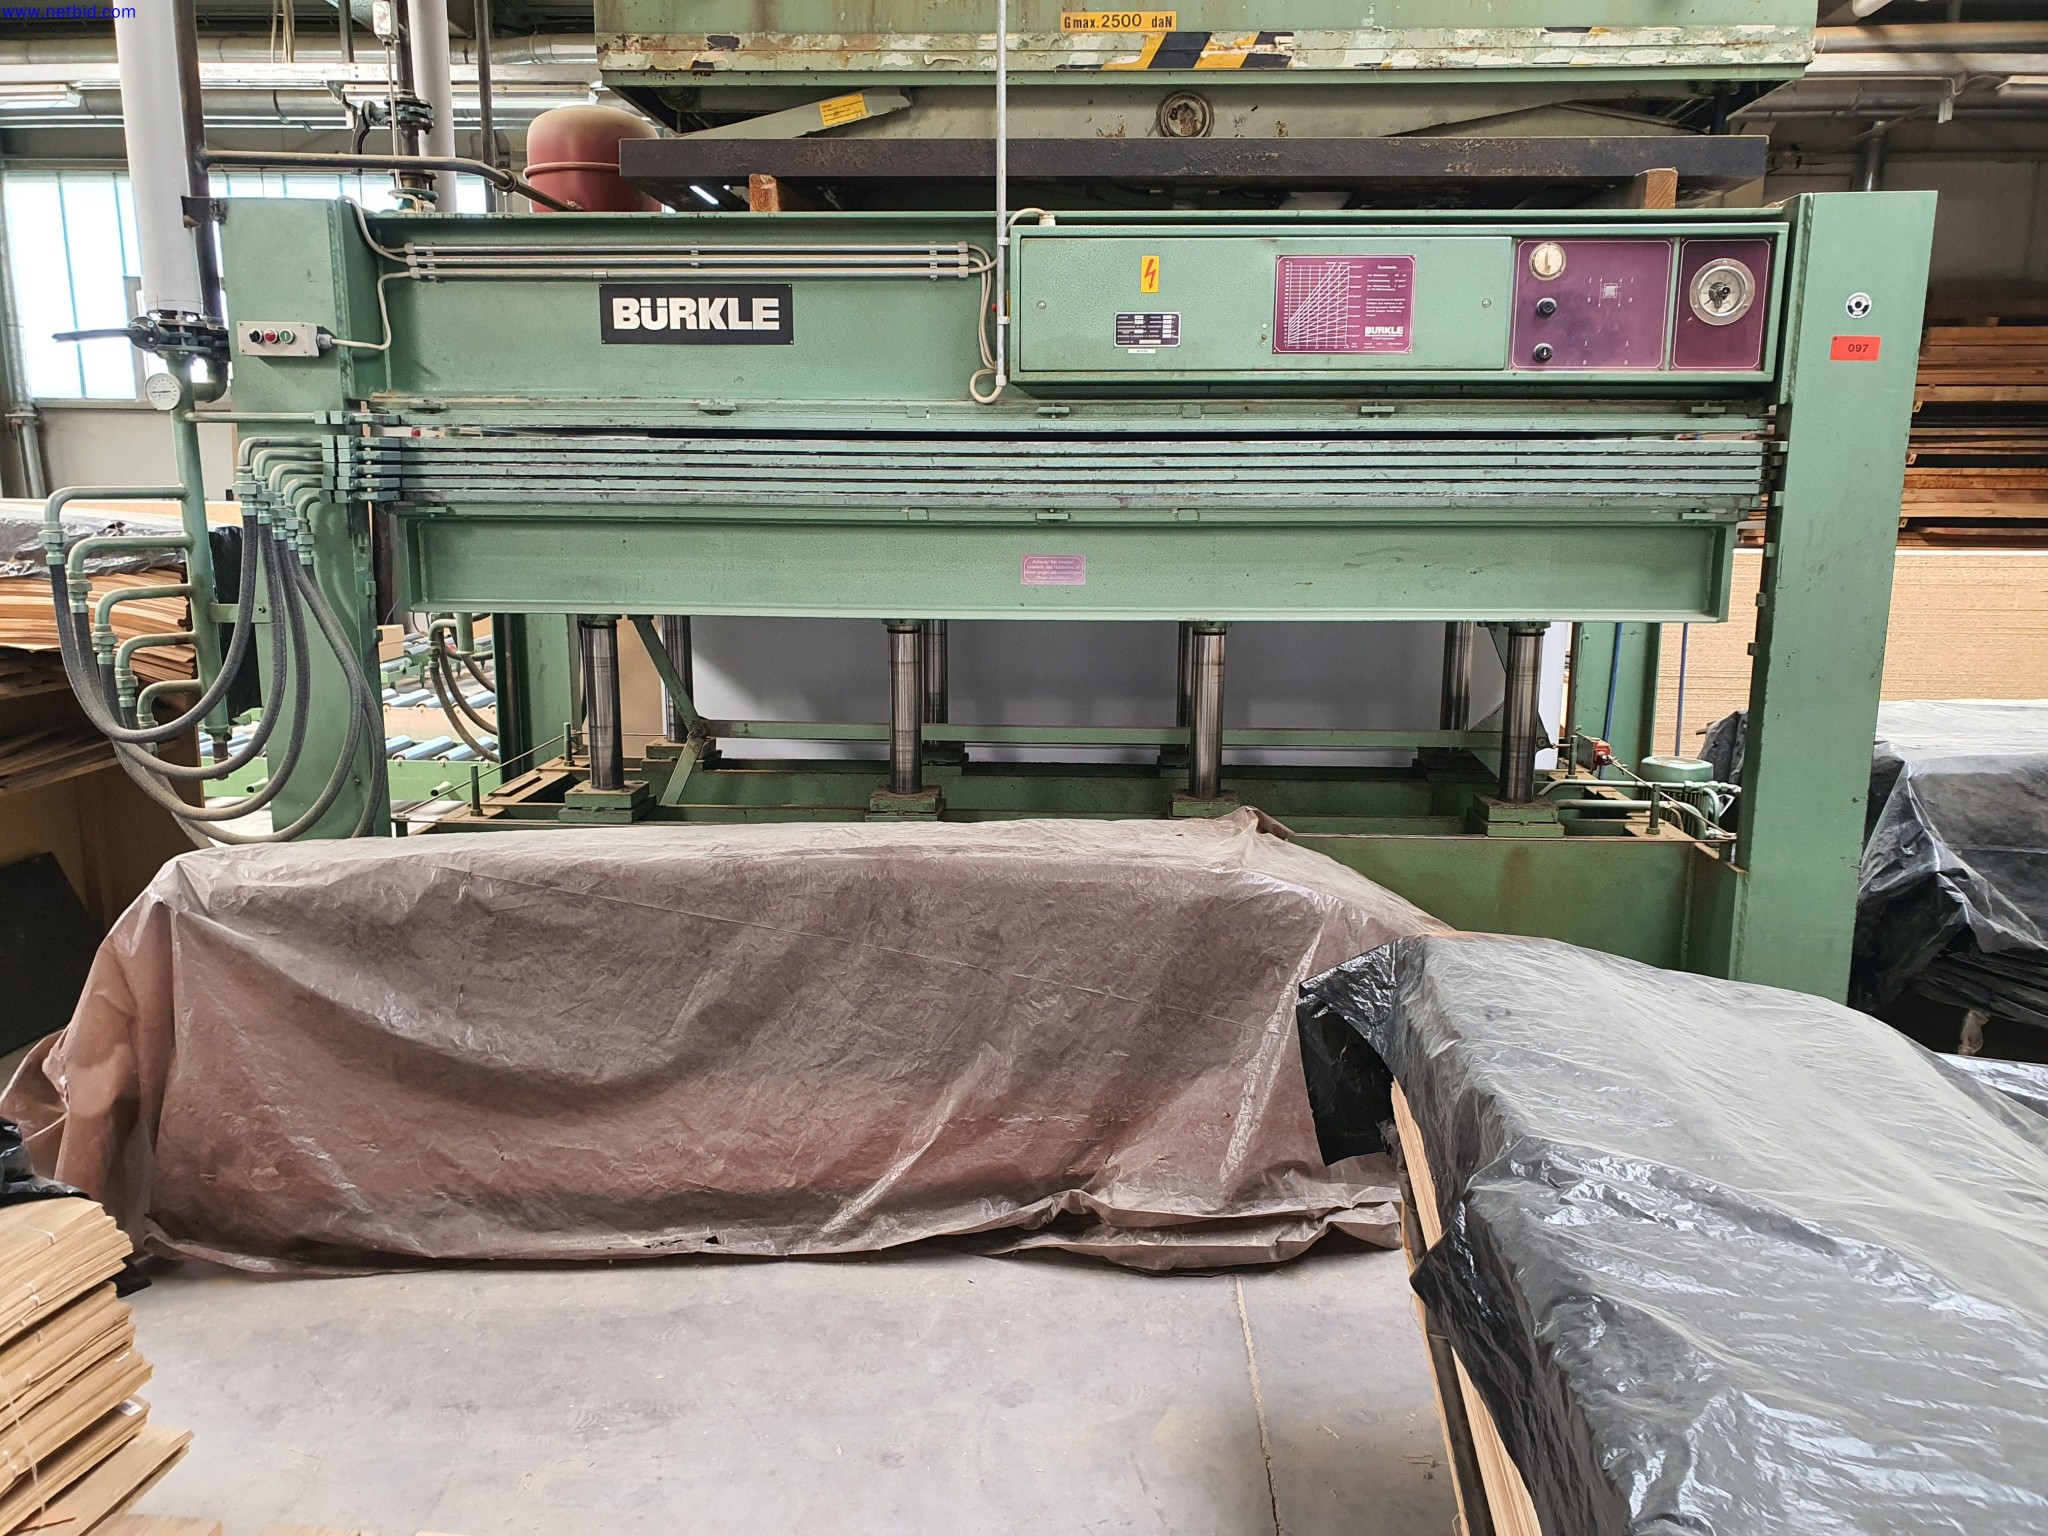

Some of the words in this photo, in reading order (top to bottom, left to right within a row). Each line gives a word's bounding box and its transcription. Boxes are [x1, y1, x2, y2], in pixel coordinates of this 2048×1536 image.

[1151, 15, 1172, 28] daN
[612, 297, 780, 331] BÜRKLE
[1848, 344, 1869, 353] 097
